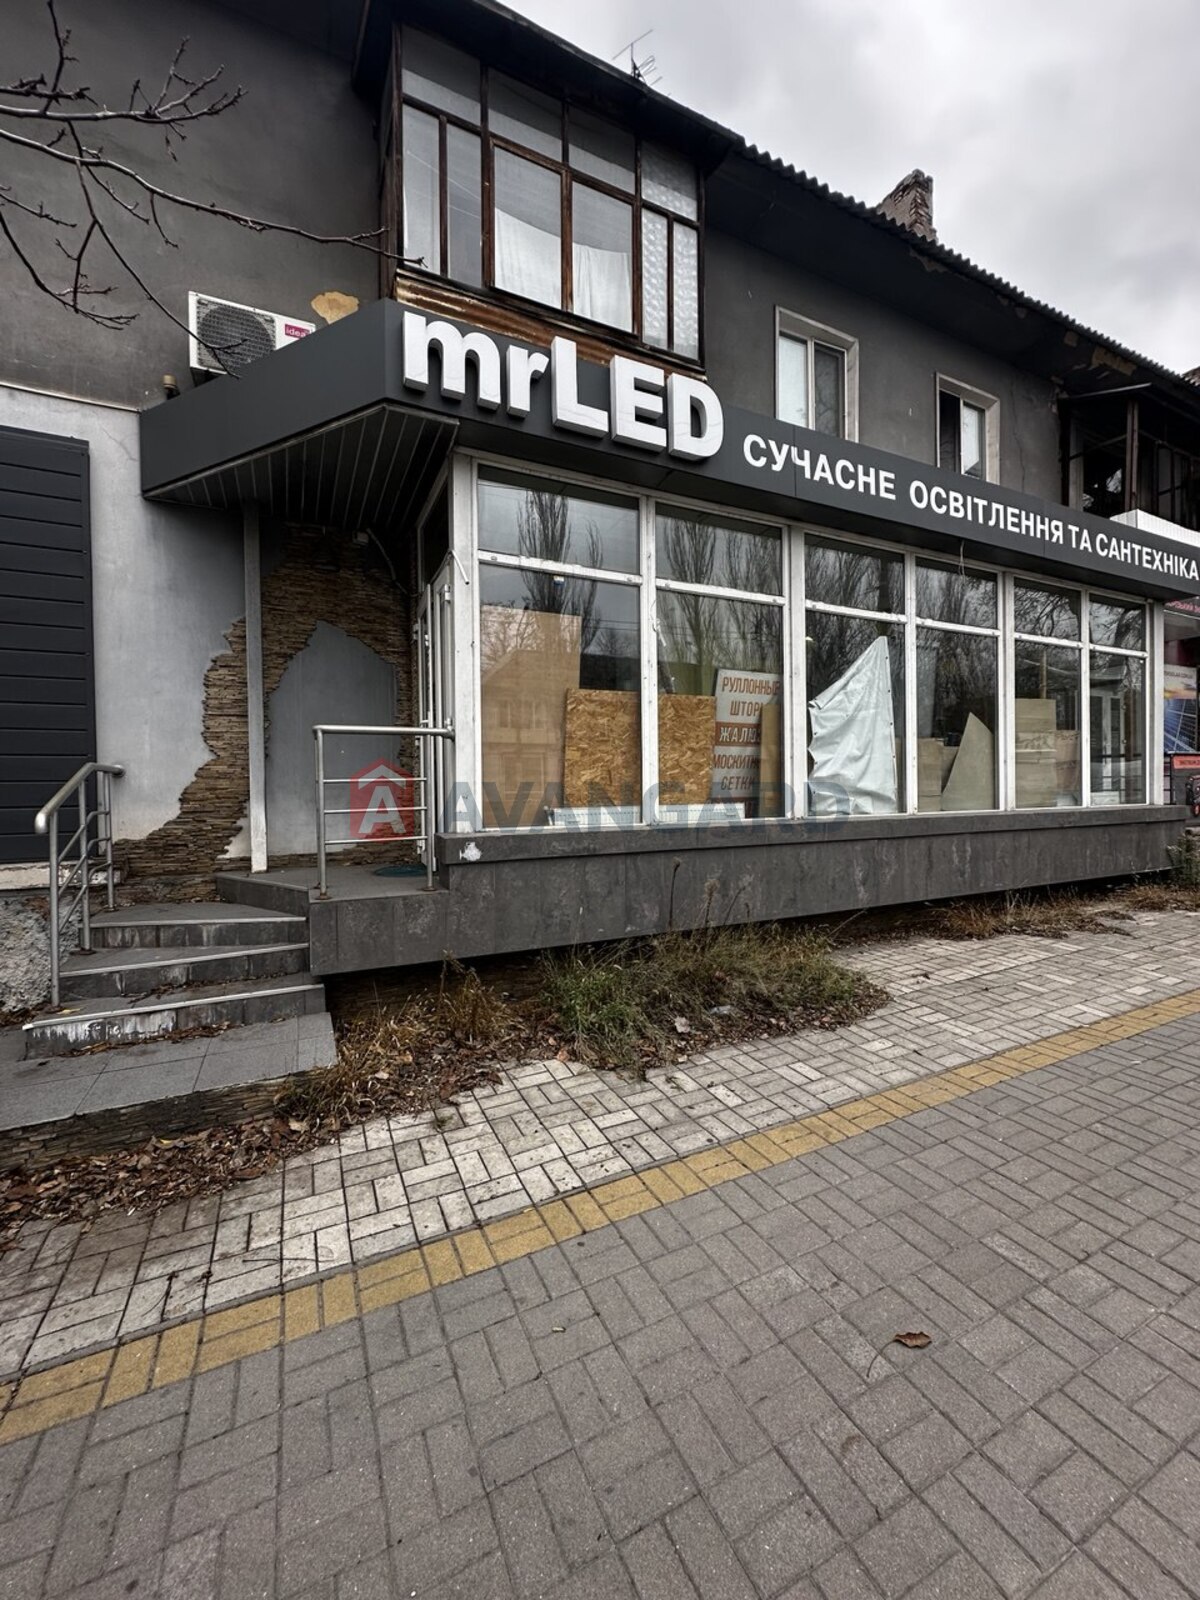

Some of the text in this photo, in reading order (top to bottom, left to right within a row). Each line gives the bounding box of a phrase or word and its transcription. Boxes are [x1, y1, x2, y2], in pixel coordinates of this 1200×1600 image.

[402, 311, 724, 461] mrLED
[743, 434, 1200, 581] СУЧАСНЕ ОСВІТЛЕННЯ ТА САНТЕХНІКА
[730, 700, 763, 717] ШТОР
